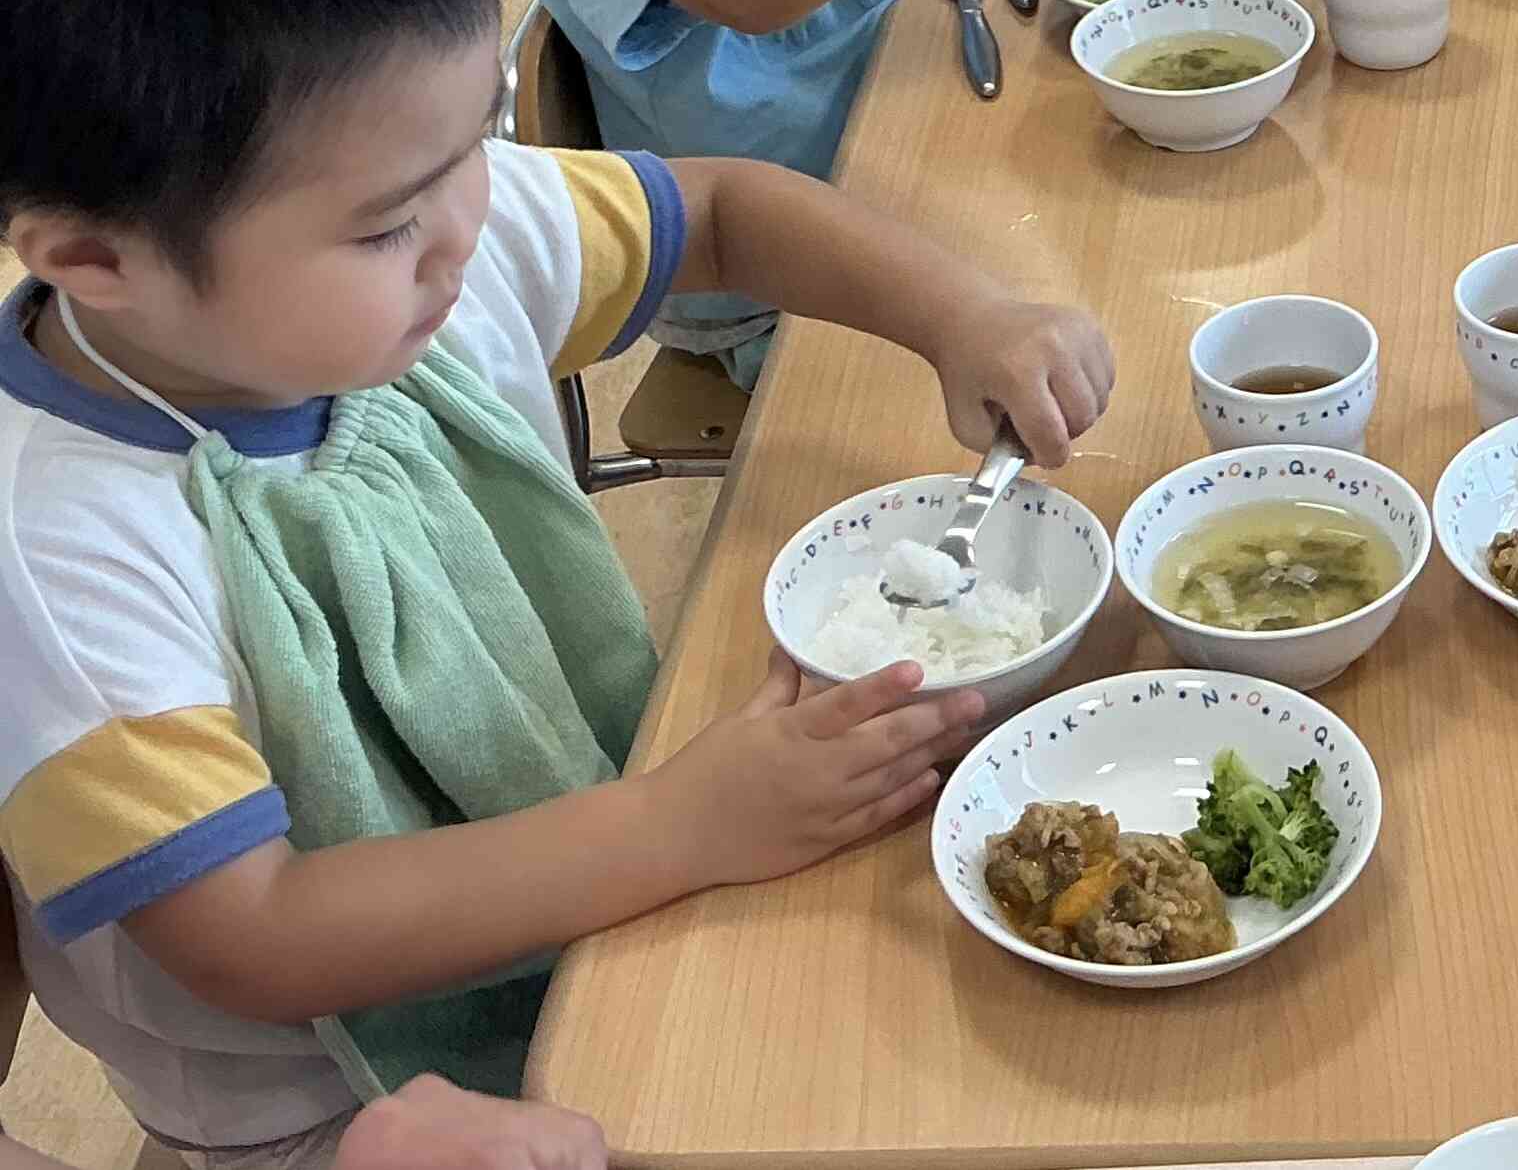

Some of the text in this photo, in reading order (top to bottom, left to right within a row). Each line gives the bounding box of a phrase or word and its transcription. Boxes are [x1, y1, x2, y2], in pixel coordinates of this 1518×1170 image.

[1197, 476, 1215, 494] N
[1228, 462, 1242, 477] O
[1257, 466, 1268, 480] P
[1289, 460, 1305, 475] Q
[805, 543, 816, 558] D
[929, 495, 944, 508] H
[986, 755, 1001, 770] I
[1063, 715, 1078, 732] K
[1103, 692, 1114, 708] L
[1149, 681, 1165, 699] M
[1201, 689, 1219, 708] N
[1246, 691, 1262, 707] O
[1278, 710, 1290, 724] P
[1314, 726, 1328, 747] Q
